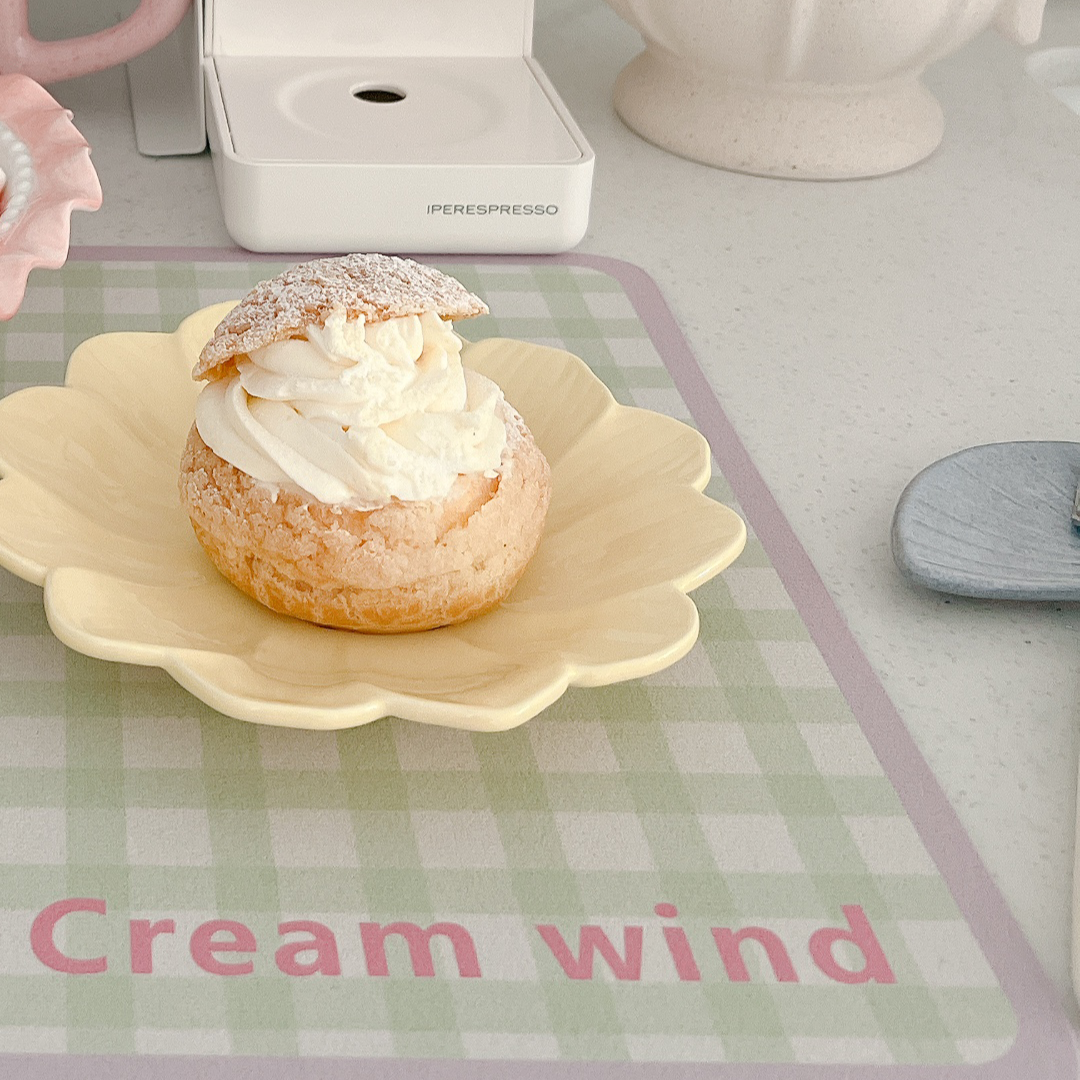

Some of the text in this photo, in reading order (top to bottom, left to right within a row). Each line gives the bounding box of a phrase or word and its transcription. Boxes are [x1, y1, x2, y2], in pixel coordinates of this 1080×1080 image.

[426, 204, 559, 215] IPERESPRESSO
[29, 896, 899, 985] Cream wind
